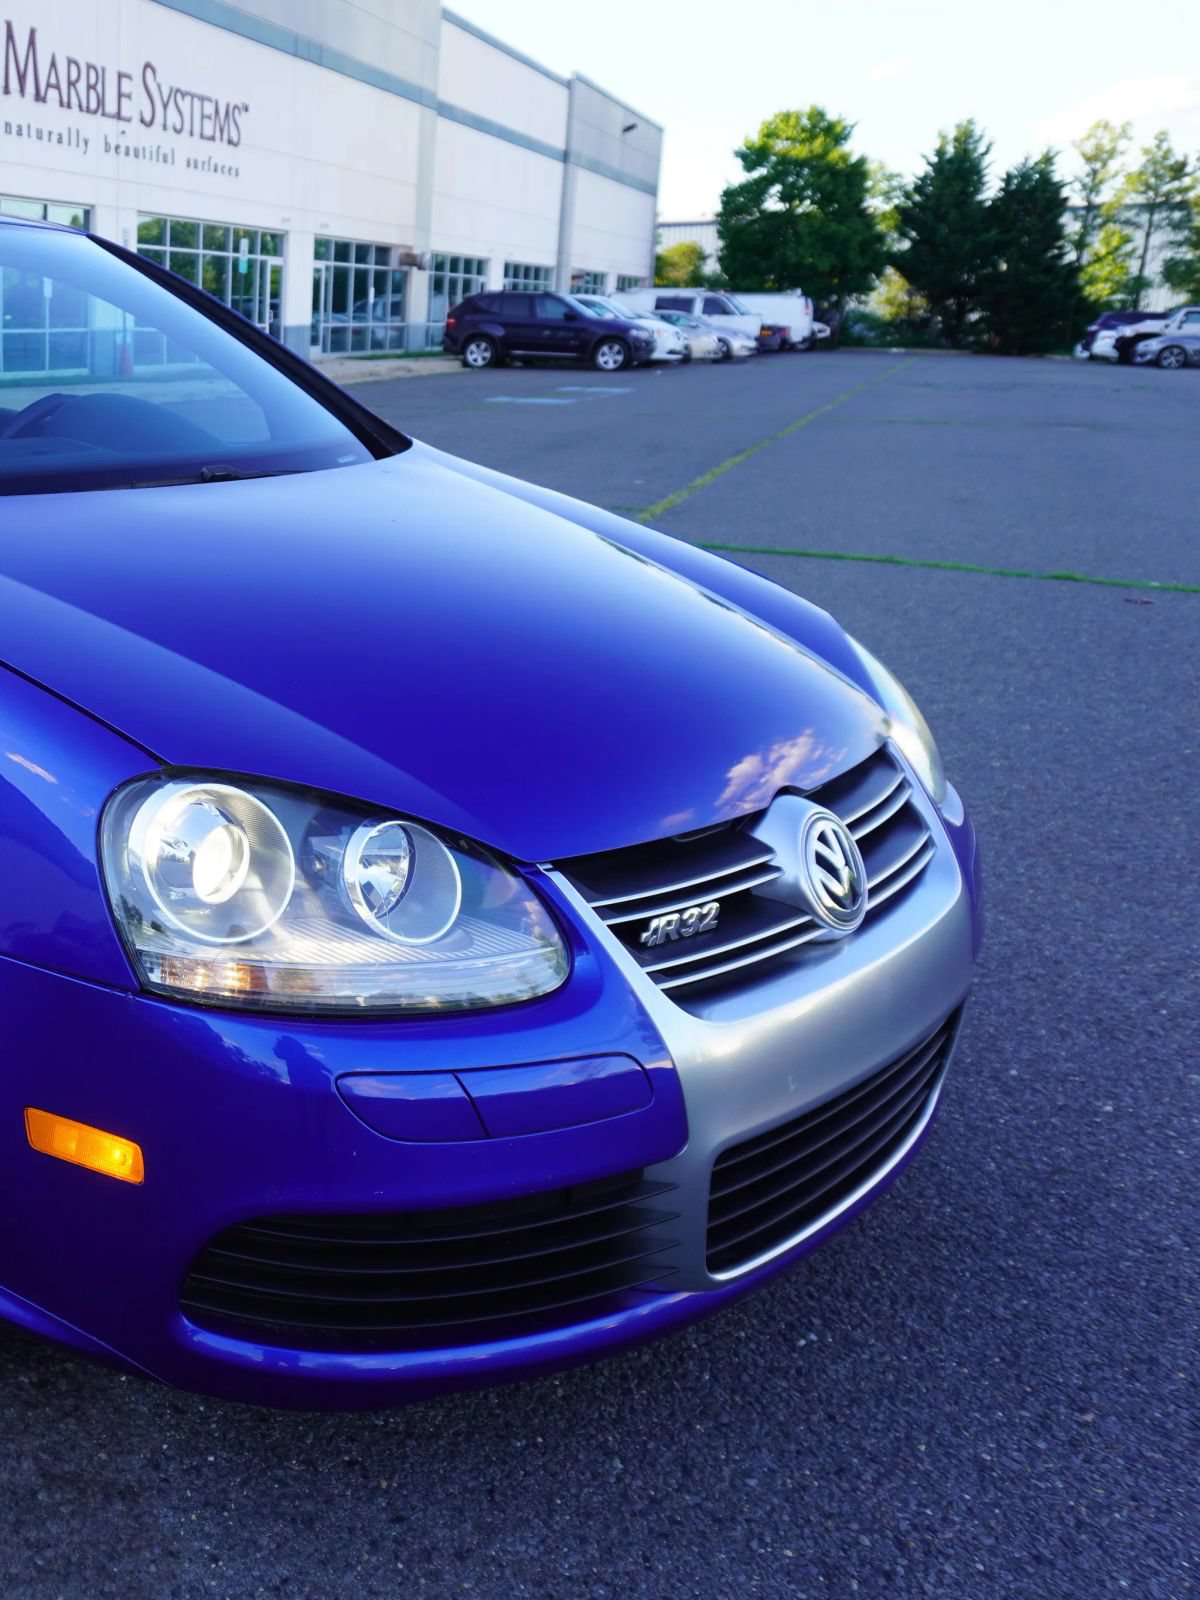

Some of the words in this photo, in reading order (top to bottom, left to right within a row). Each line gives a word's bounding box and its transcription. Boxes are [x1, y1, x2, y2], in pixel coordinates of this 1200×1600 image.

[3, 20, 133, 122] MARBLE
[4, 121, 90, 154] naturally
[104, 135, 175, 165] beautiful
[186, 155, 240, 178] surfaces
[642, 902, 720, 946] R32
